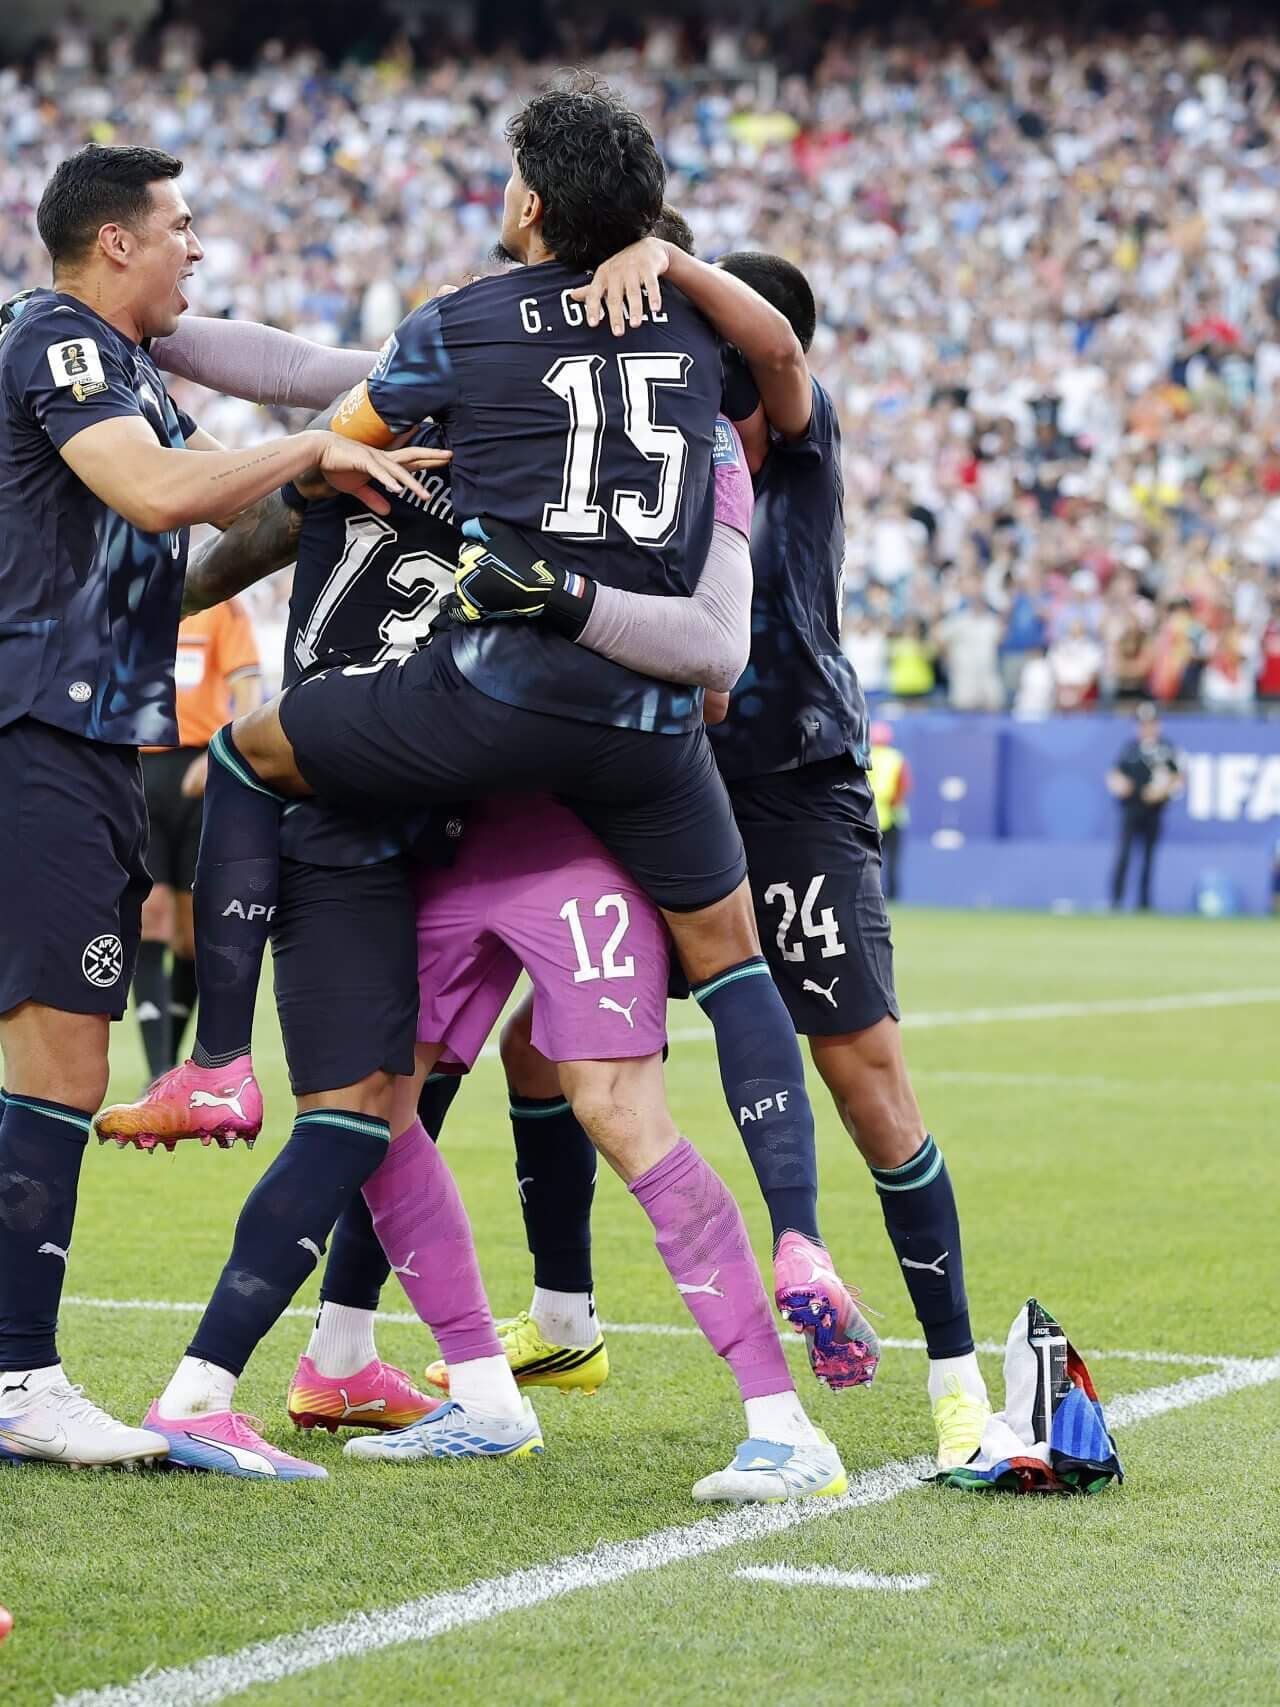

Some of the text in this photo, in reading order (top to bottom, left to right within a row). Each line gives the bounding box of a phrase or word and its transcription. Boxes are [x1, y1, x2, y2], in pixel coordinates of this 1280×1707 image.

[520, 298, 552, 333] G.
[541, 353, 694, 548] 15
[1184, 752, 1280, 822] IFA
[560, 893, 635, 983] 12
[764, 874, 846, 962] 24
[740, 1090, 788, 1126] APF
